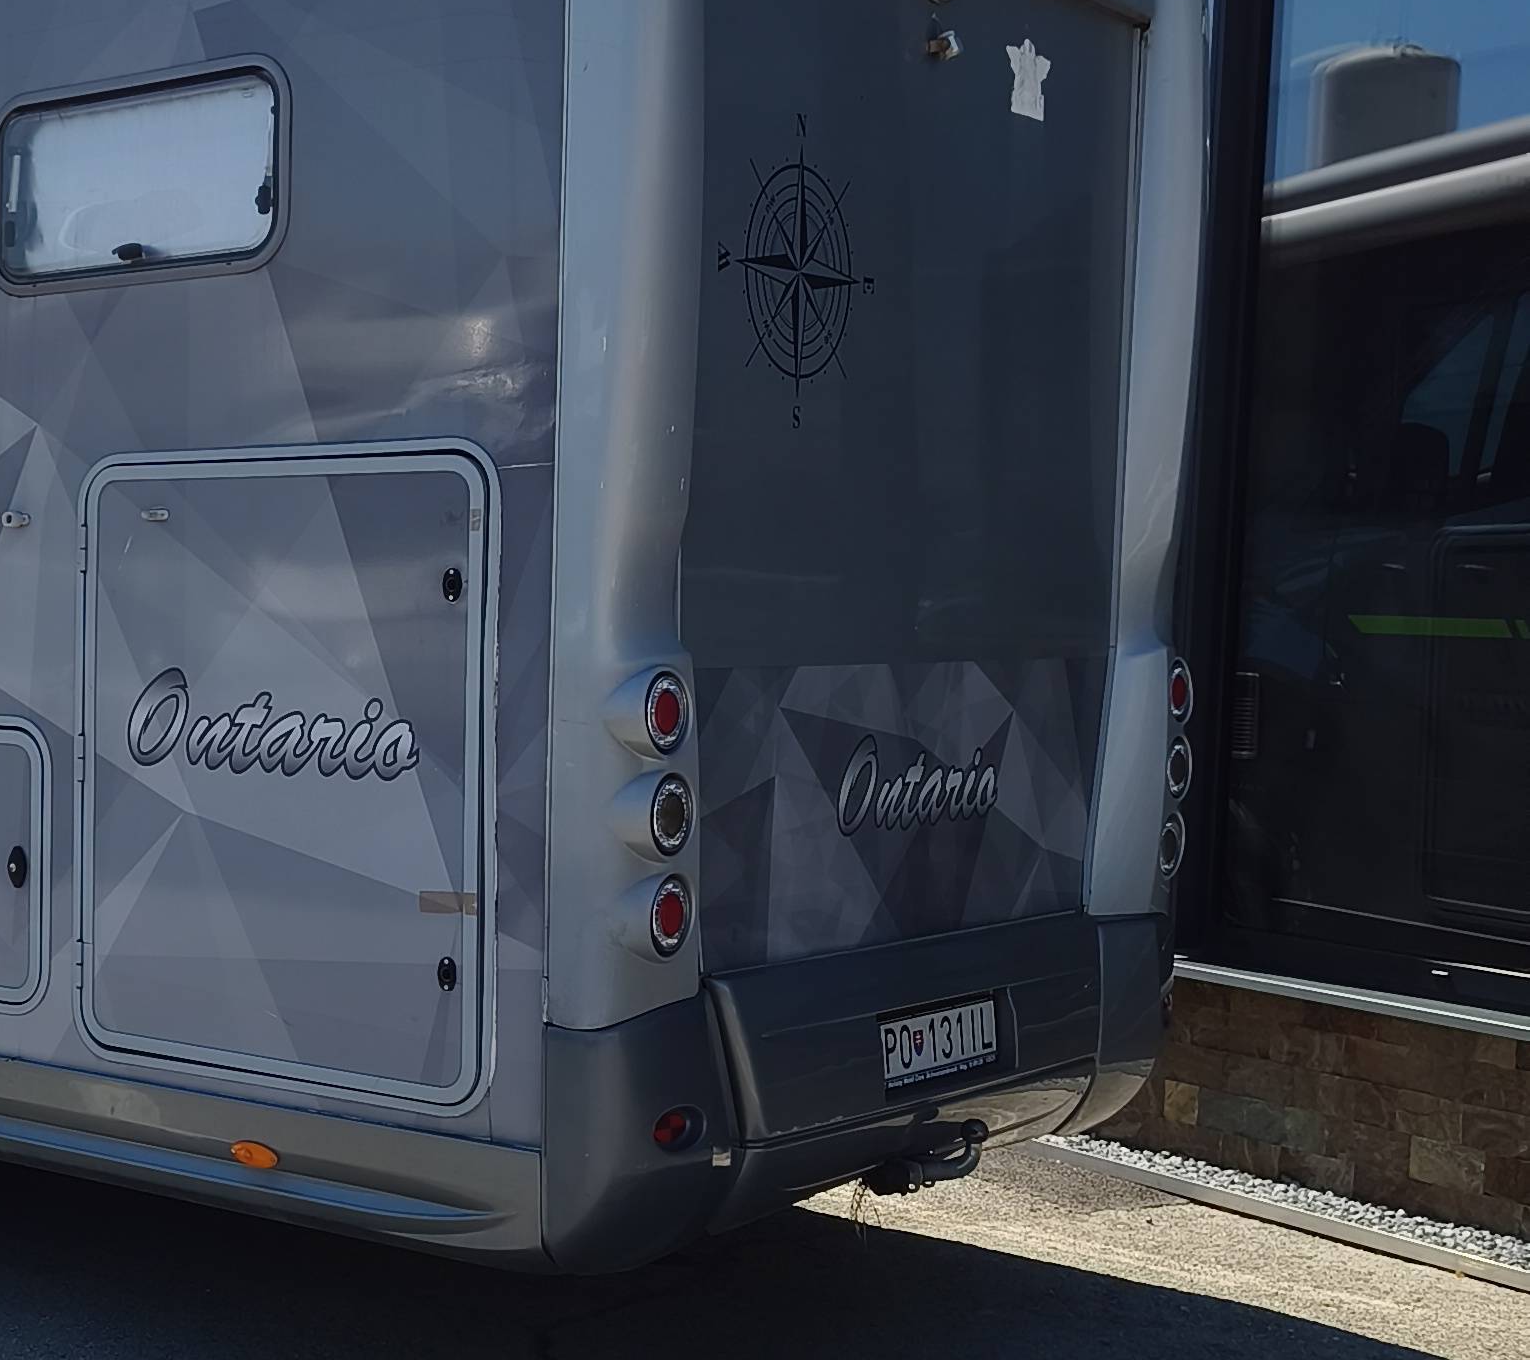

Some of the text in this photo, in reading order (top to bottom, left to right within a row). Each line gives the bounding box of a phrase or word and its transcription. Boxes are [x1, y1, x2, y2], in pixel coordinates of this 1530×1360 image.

[796, 113, 807, 138] N
[792, 405, 801, 429] S
[127, 666, 420, 782] Ontario
[837, 734, 998, 837] Ontario
[883, 1024, 913, 1075] PO
